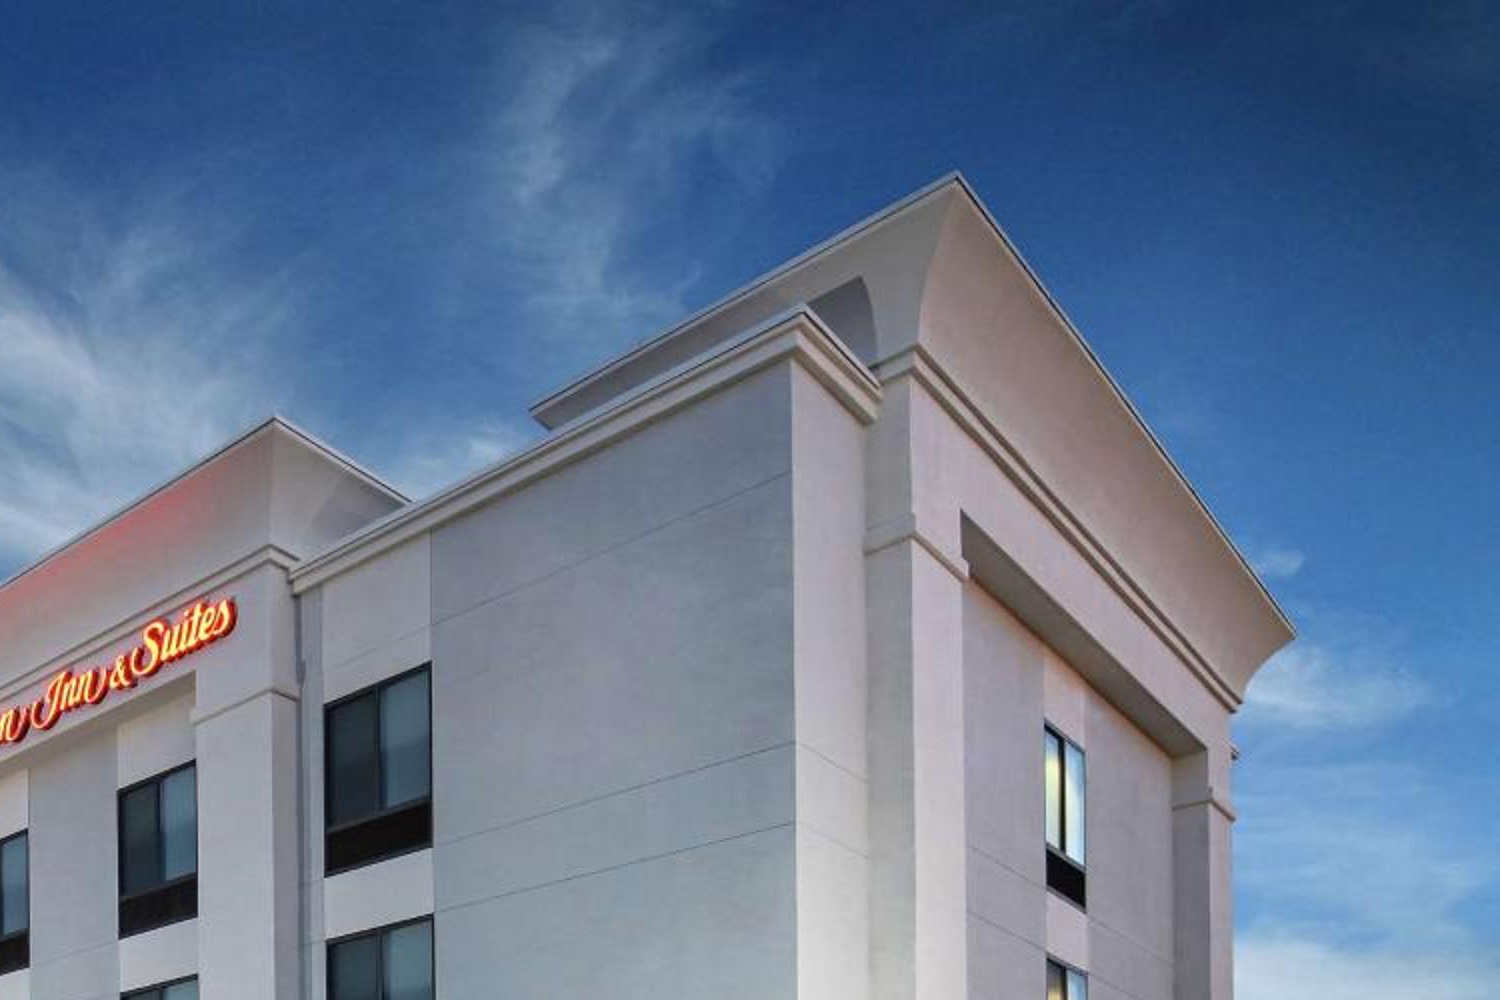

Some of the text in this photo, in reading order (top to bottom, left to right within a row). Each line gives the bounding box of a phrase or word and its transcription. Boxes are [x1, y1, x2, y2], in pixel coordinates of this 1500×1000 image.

[30, 669, 107, 730] Inn
[108, 653, 138, 691] &
[130, 596, 238, 677] Suites
